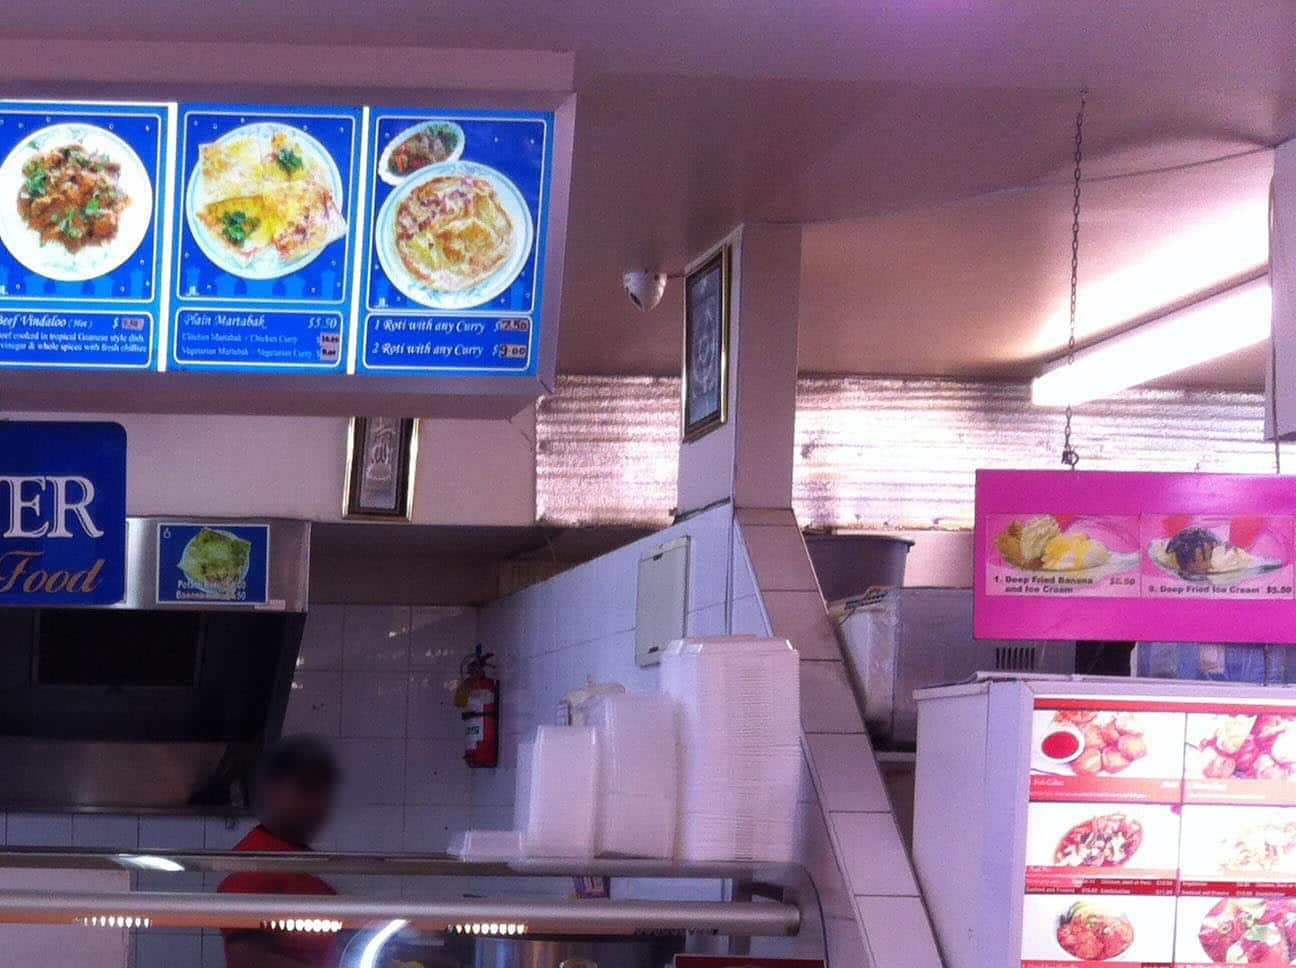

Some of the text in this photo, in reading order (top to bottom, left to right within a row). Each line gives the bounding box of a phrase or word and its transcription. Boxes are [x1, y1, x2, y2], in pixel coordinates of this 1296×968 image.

[19, 315, 67, 328] Vindaloo
[184, 314, 212, 327] Plain
[383, 320, 407, 334] Roti
[409, 320, 433, 332] with
[435, 322, 455, 334] any
[456, 321, 485, 335] Curry
[381, 343, 404, 356] Roti
[406, 343, 431, 355] with
[433, 345, 454, 357] any
[454, 344, 484, 357] Curry
[1005, 575, 1029, 585] Deep
[1031, 575, 1056, 584] Fried
[1058, 576, 1093, 585] Banana
[1005, 585, 1074, 594] and Ice Cream
[1160, 585, 1184, 595] Deep
[1186, 585, 1210, 593] Fried
[1213, 585, 1227, 593] Ice
[1229, 585, 1260, 594] Cream
